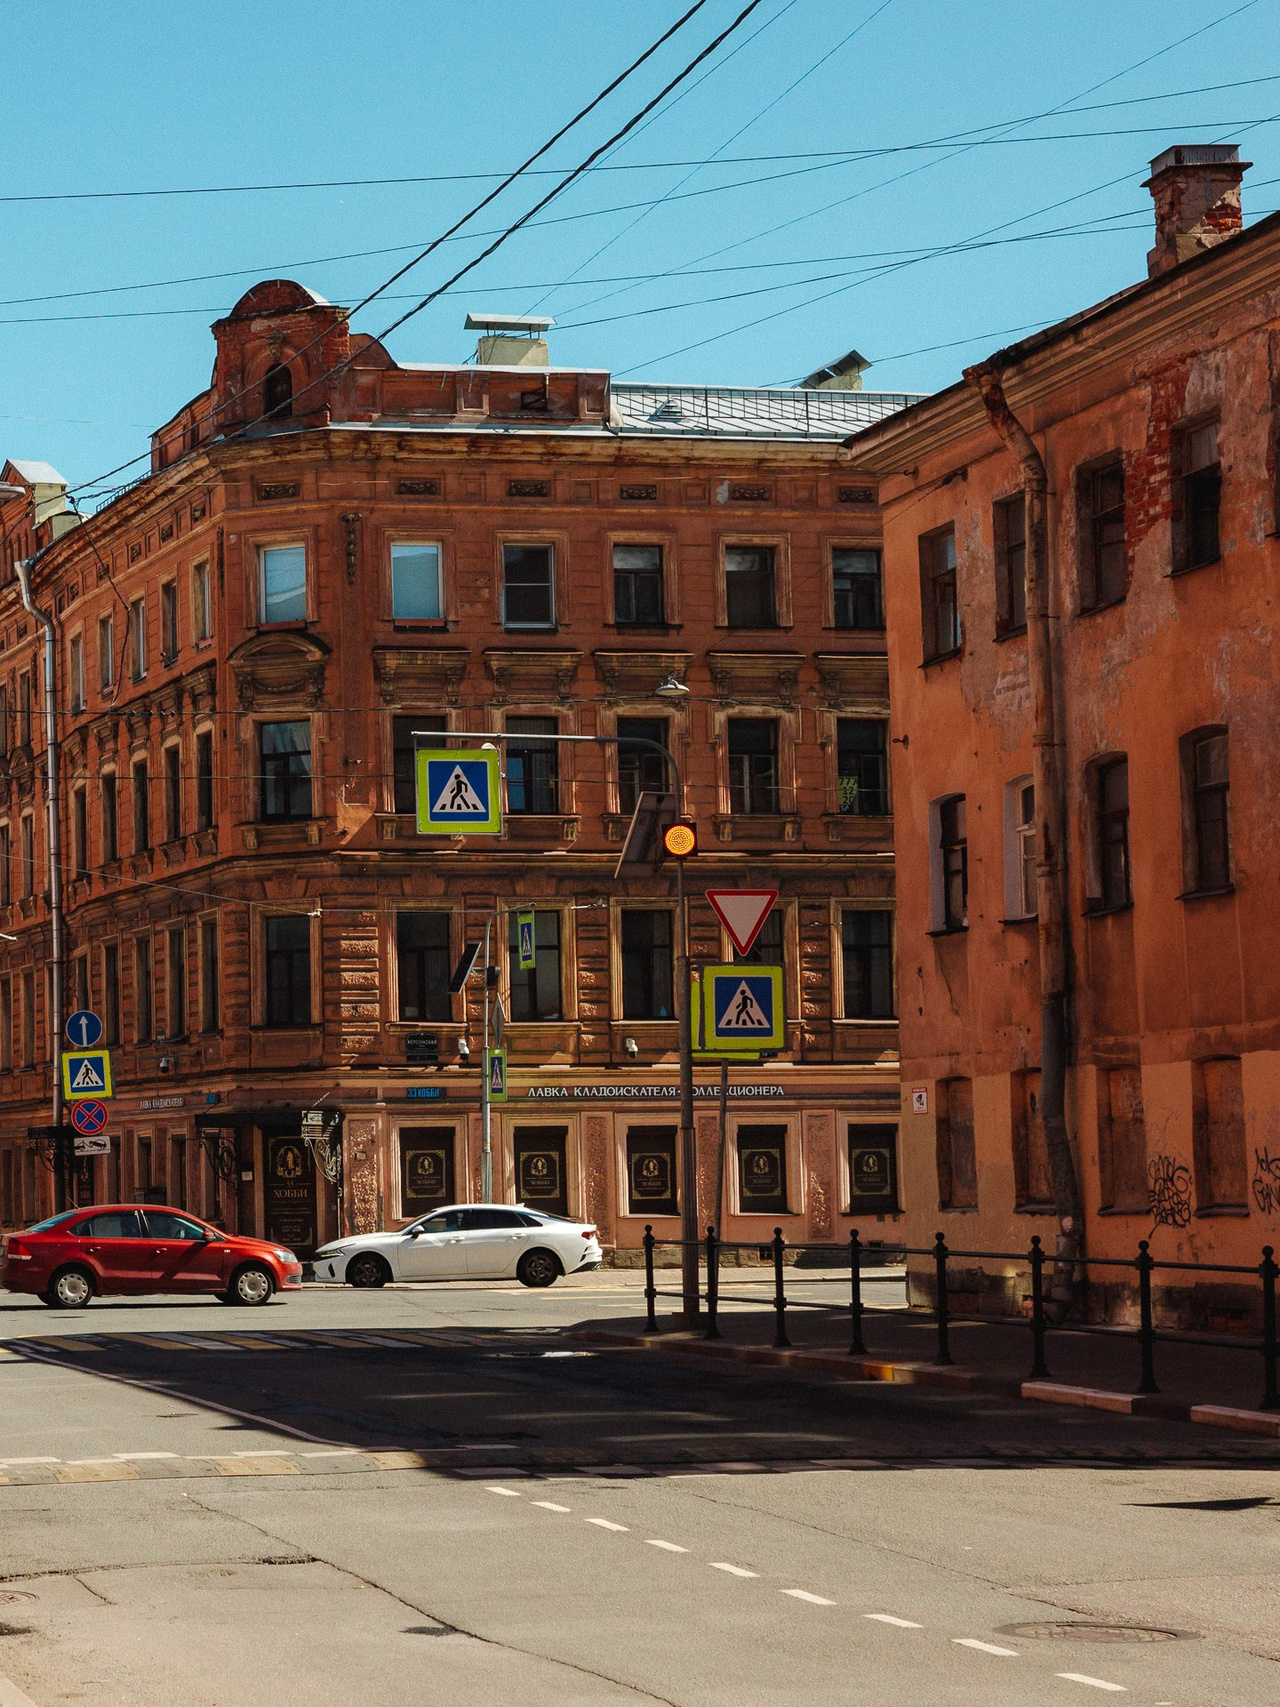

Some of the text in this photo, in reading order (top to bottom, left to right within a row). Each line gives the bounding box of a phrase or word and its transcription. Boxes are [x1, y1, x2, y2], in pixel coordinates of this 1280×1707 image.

[407, 1088, 440, 1098] 33 ХОББИ
[527, 1085, 785, 1097] ЛАВКА КЛАДОИСКАТЕЛЯ ОЛЛЕЦИОНЕРА
[273, 1188, 308, 1198] ХОББИ
